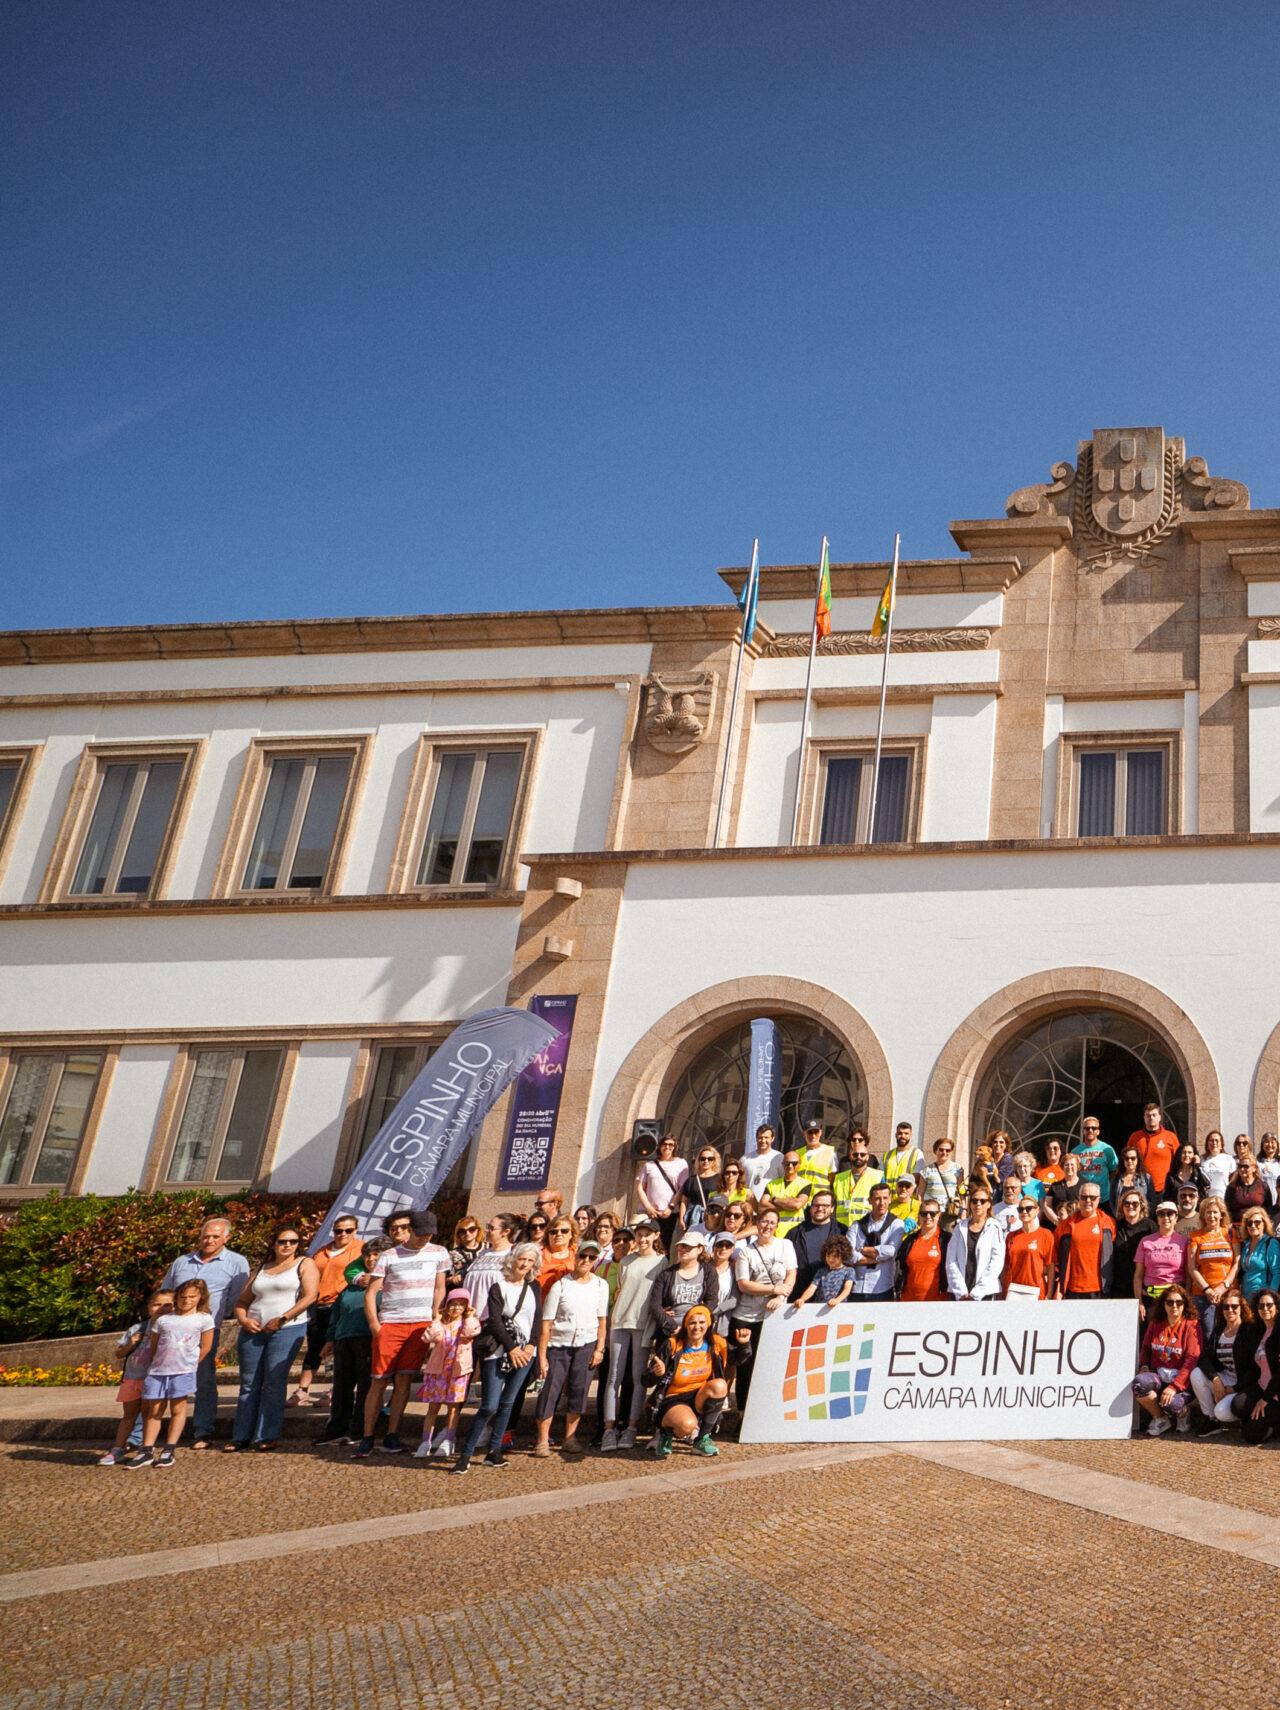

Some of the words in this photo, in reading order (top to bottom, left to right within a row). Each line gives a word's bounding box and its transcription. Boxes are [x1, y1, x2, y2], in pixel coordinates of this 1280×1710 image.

[374, 1041, 493, 1181] ESPINHO
[409, 1123, 460, 1188] CÂMARA
[451, 1057, 514, 1137] MUNICIPAL
[883, 1381, 977, 1410] CÂMARA
[983, 1385, 1100, 1409] MUNICIPAL
[887, 1328, 1105, 1378] ESPINHO
